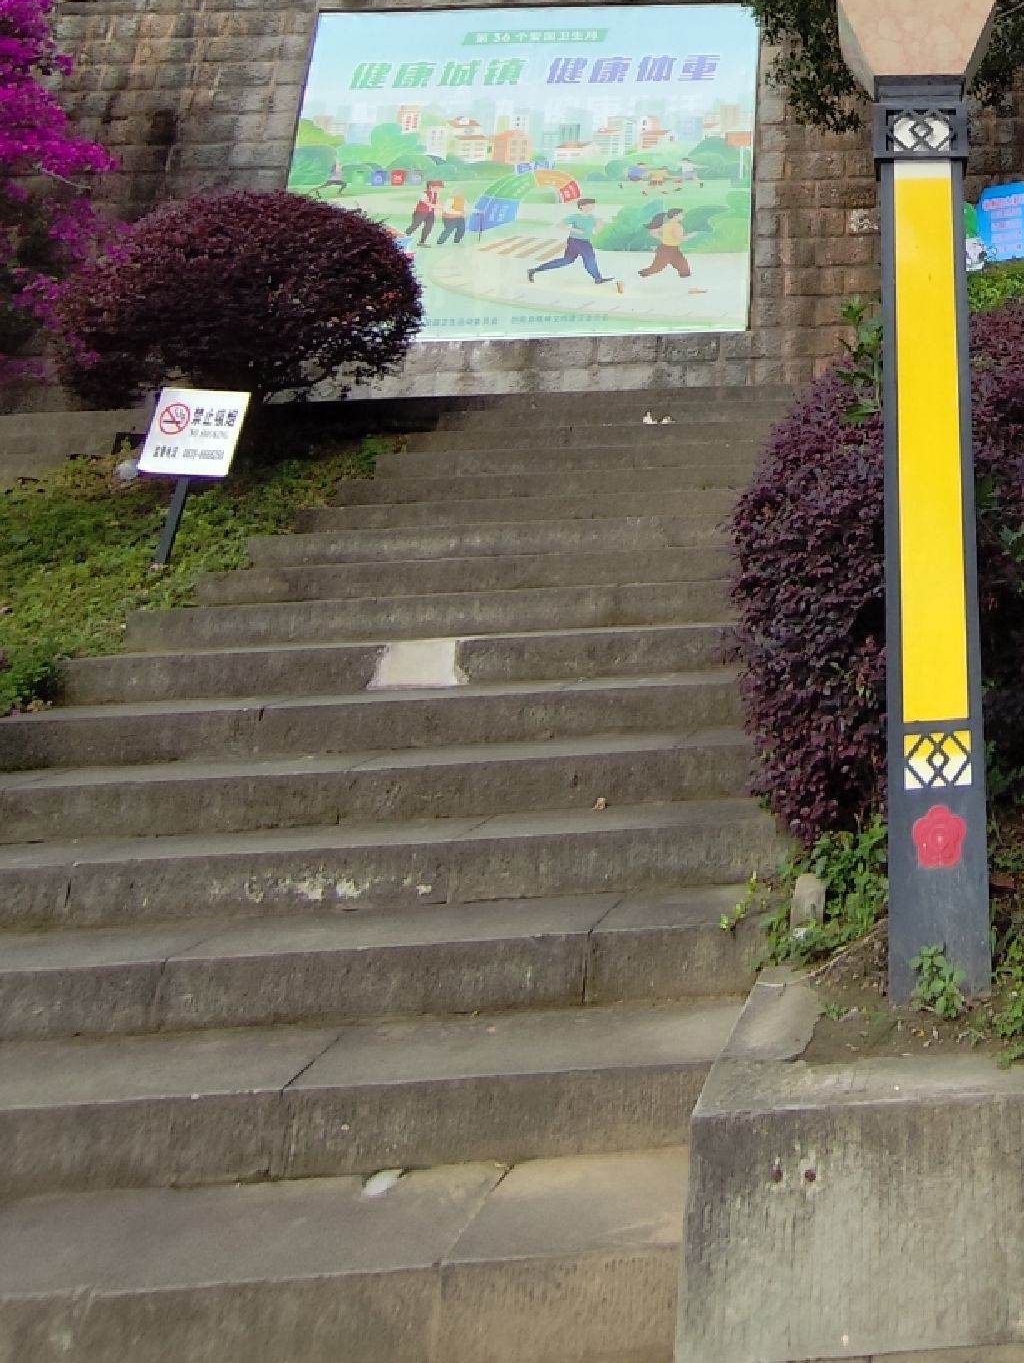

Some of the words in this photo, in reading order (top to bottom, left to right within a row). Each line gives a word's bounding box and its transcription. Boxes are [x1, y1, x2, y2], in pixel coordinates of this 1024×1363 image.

[350, 59, 528, 89] 健康城镇
[546, 54, 721, 85] 健康体重
